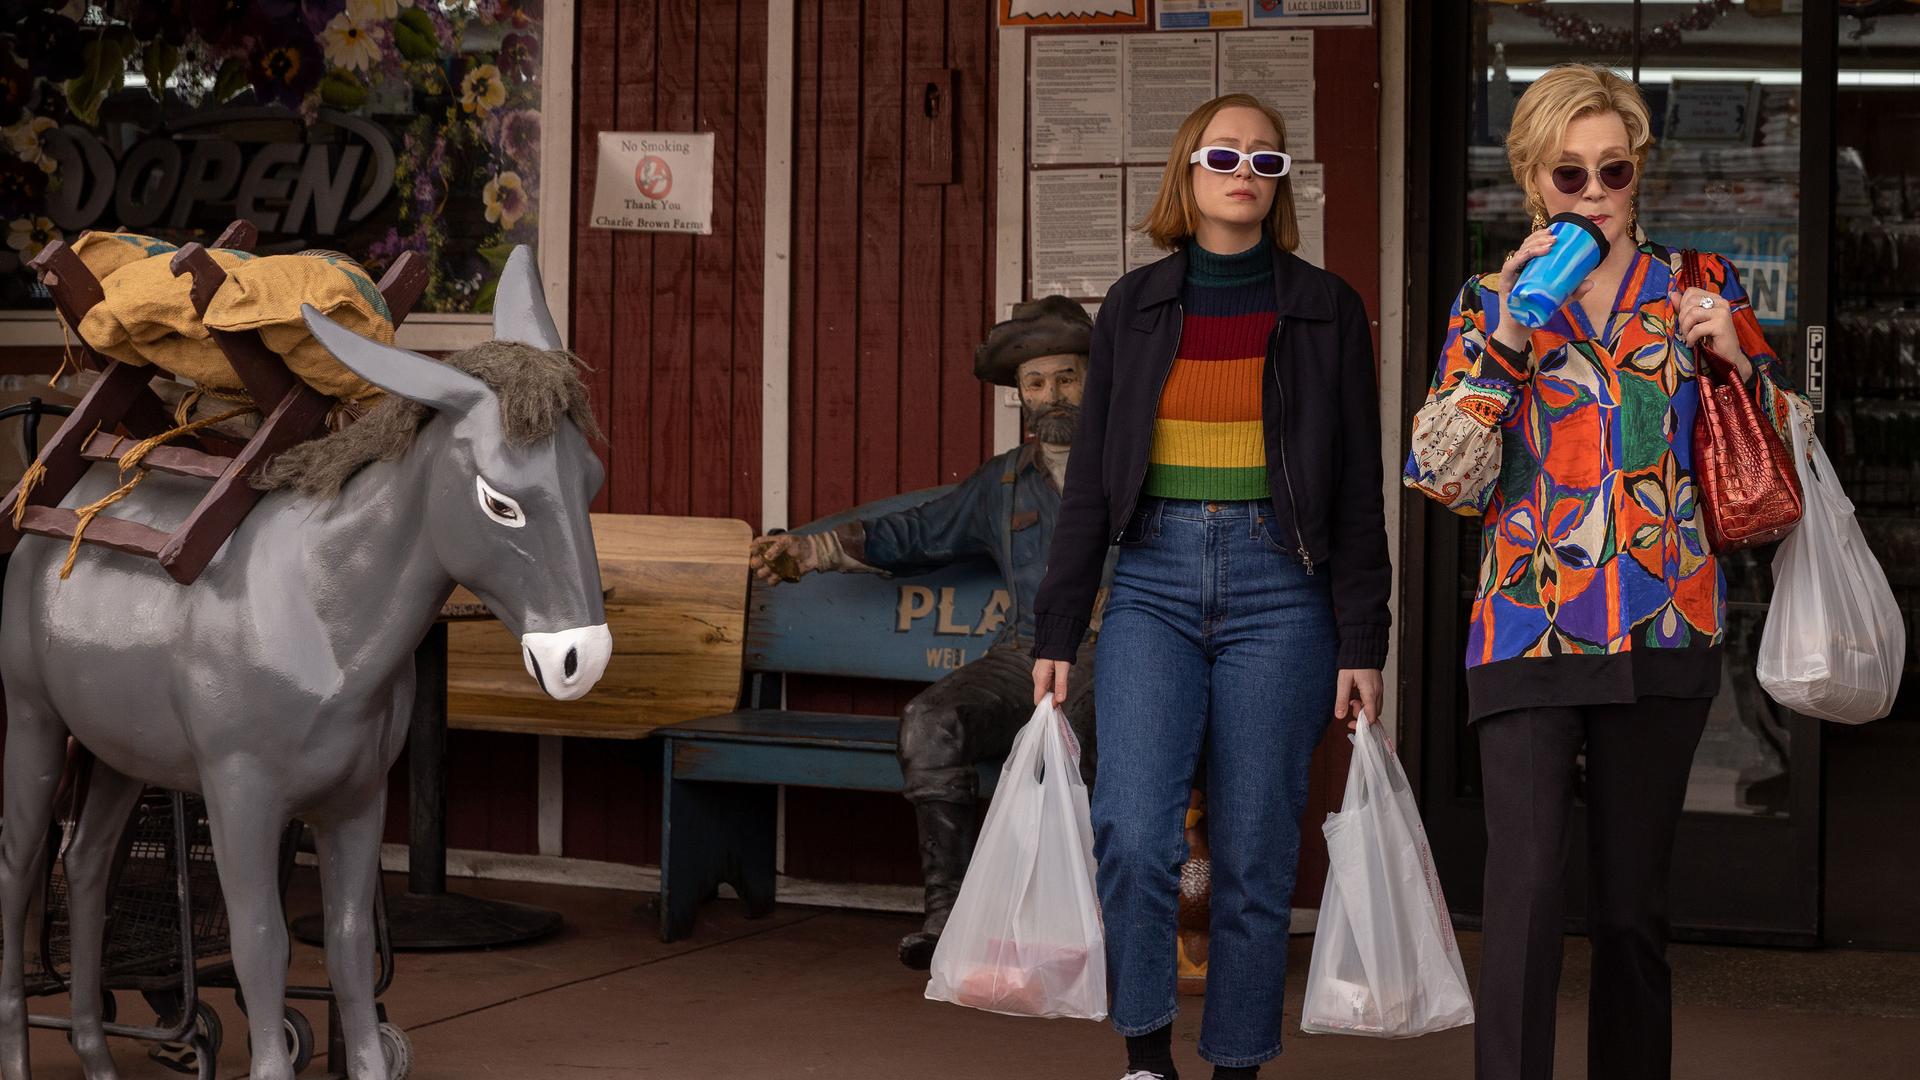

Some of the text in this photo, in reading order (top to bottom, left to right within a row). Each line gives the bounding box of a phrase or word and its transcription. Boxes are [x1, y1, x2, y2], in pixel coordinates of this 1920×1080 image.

[621, 140, 690, 155] No Smoking
[115, 139, 363, 235] OPEN
[624, 199, 681, 211] Thank You
[595, 216, 704, 231] Charlie Brown Farms
[1809, 332, 1823, 392] PULL
[895, 584, 1012, 636] PLA
